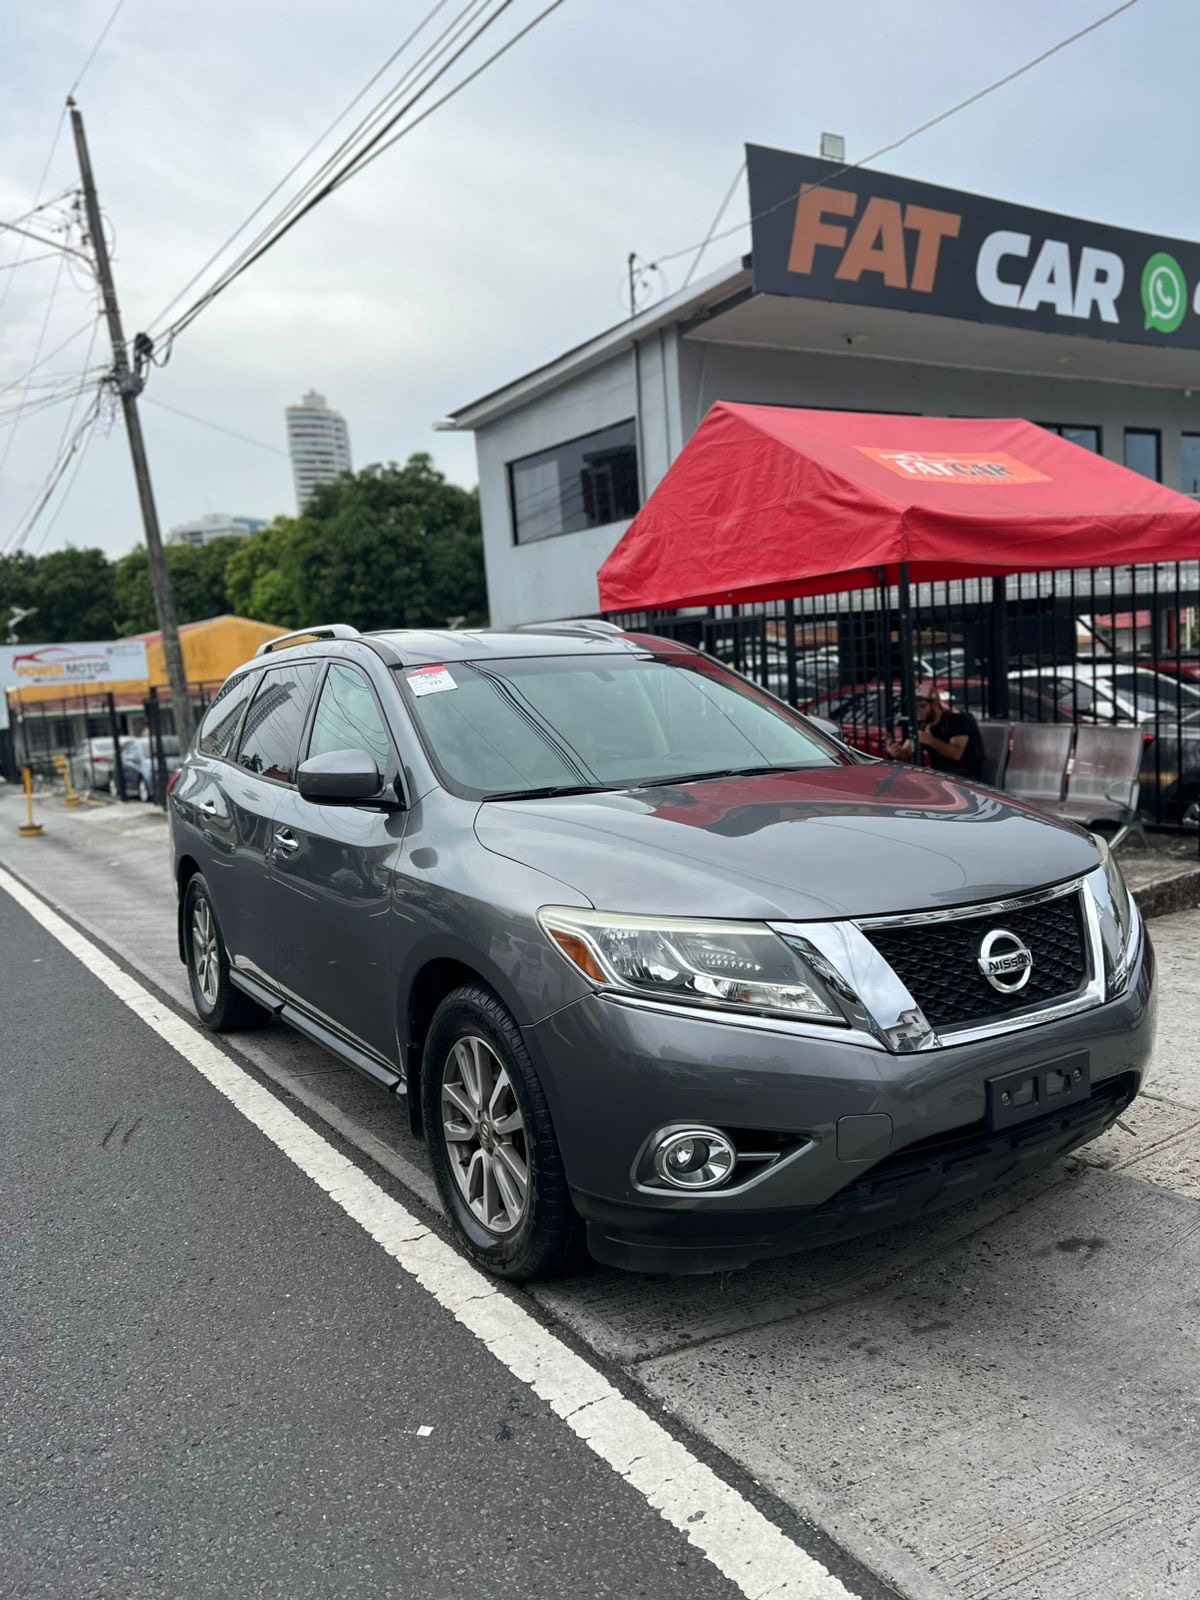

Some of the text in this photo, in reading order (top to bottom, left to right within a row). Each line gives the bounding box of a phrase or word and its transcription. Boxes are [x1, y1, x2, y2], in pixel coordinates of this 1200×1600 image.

[787, 182, 1125, 324] FAT CAR
[17, 661, 110, 678] POWER MOTOR
[988, 951, 1031, 972] NISSAN
